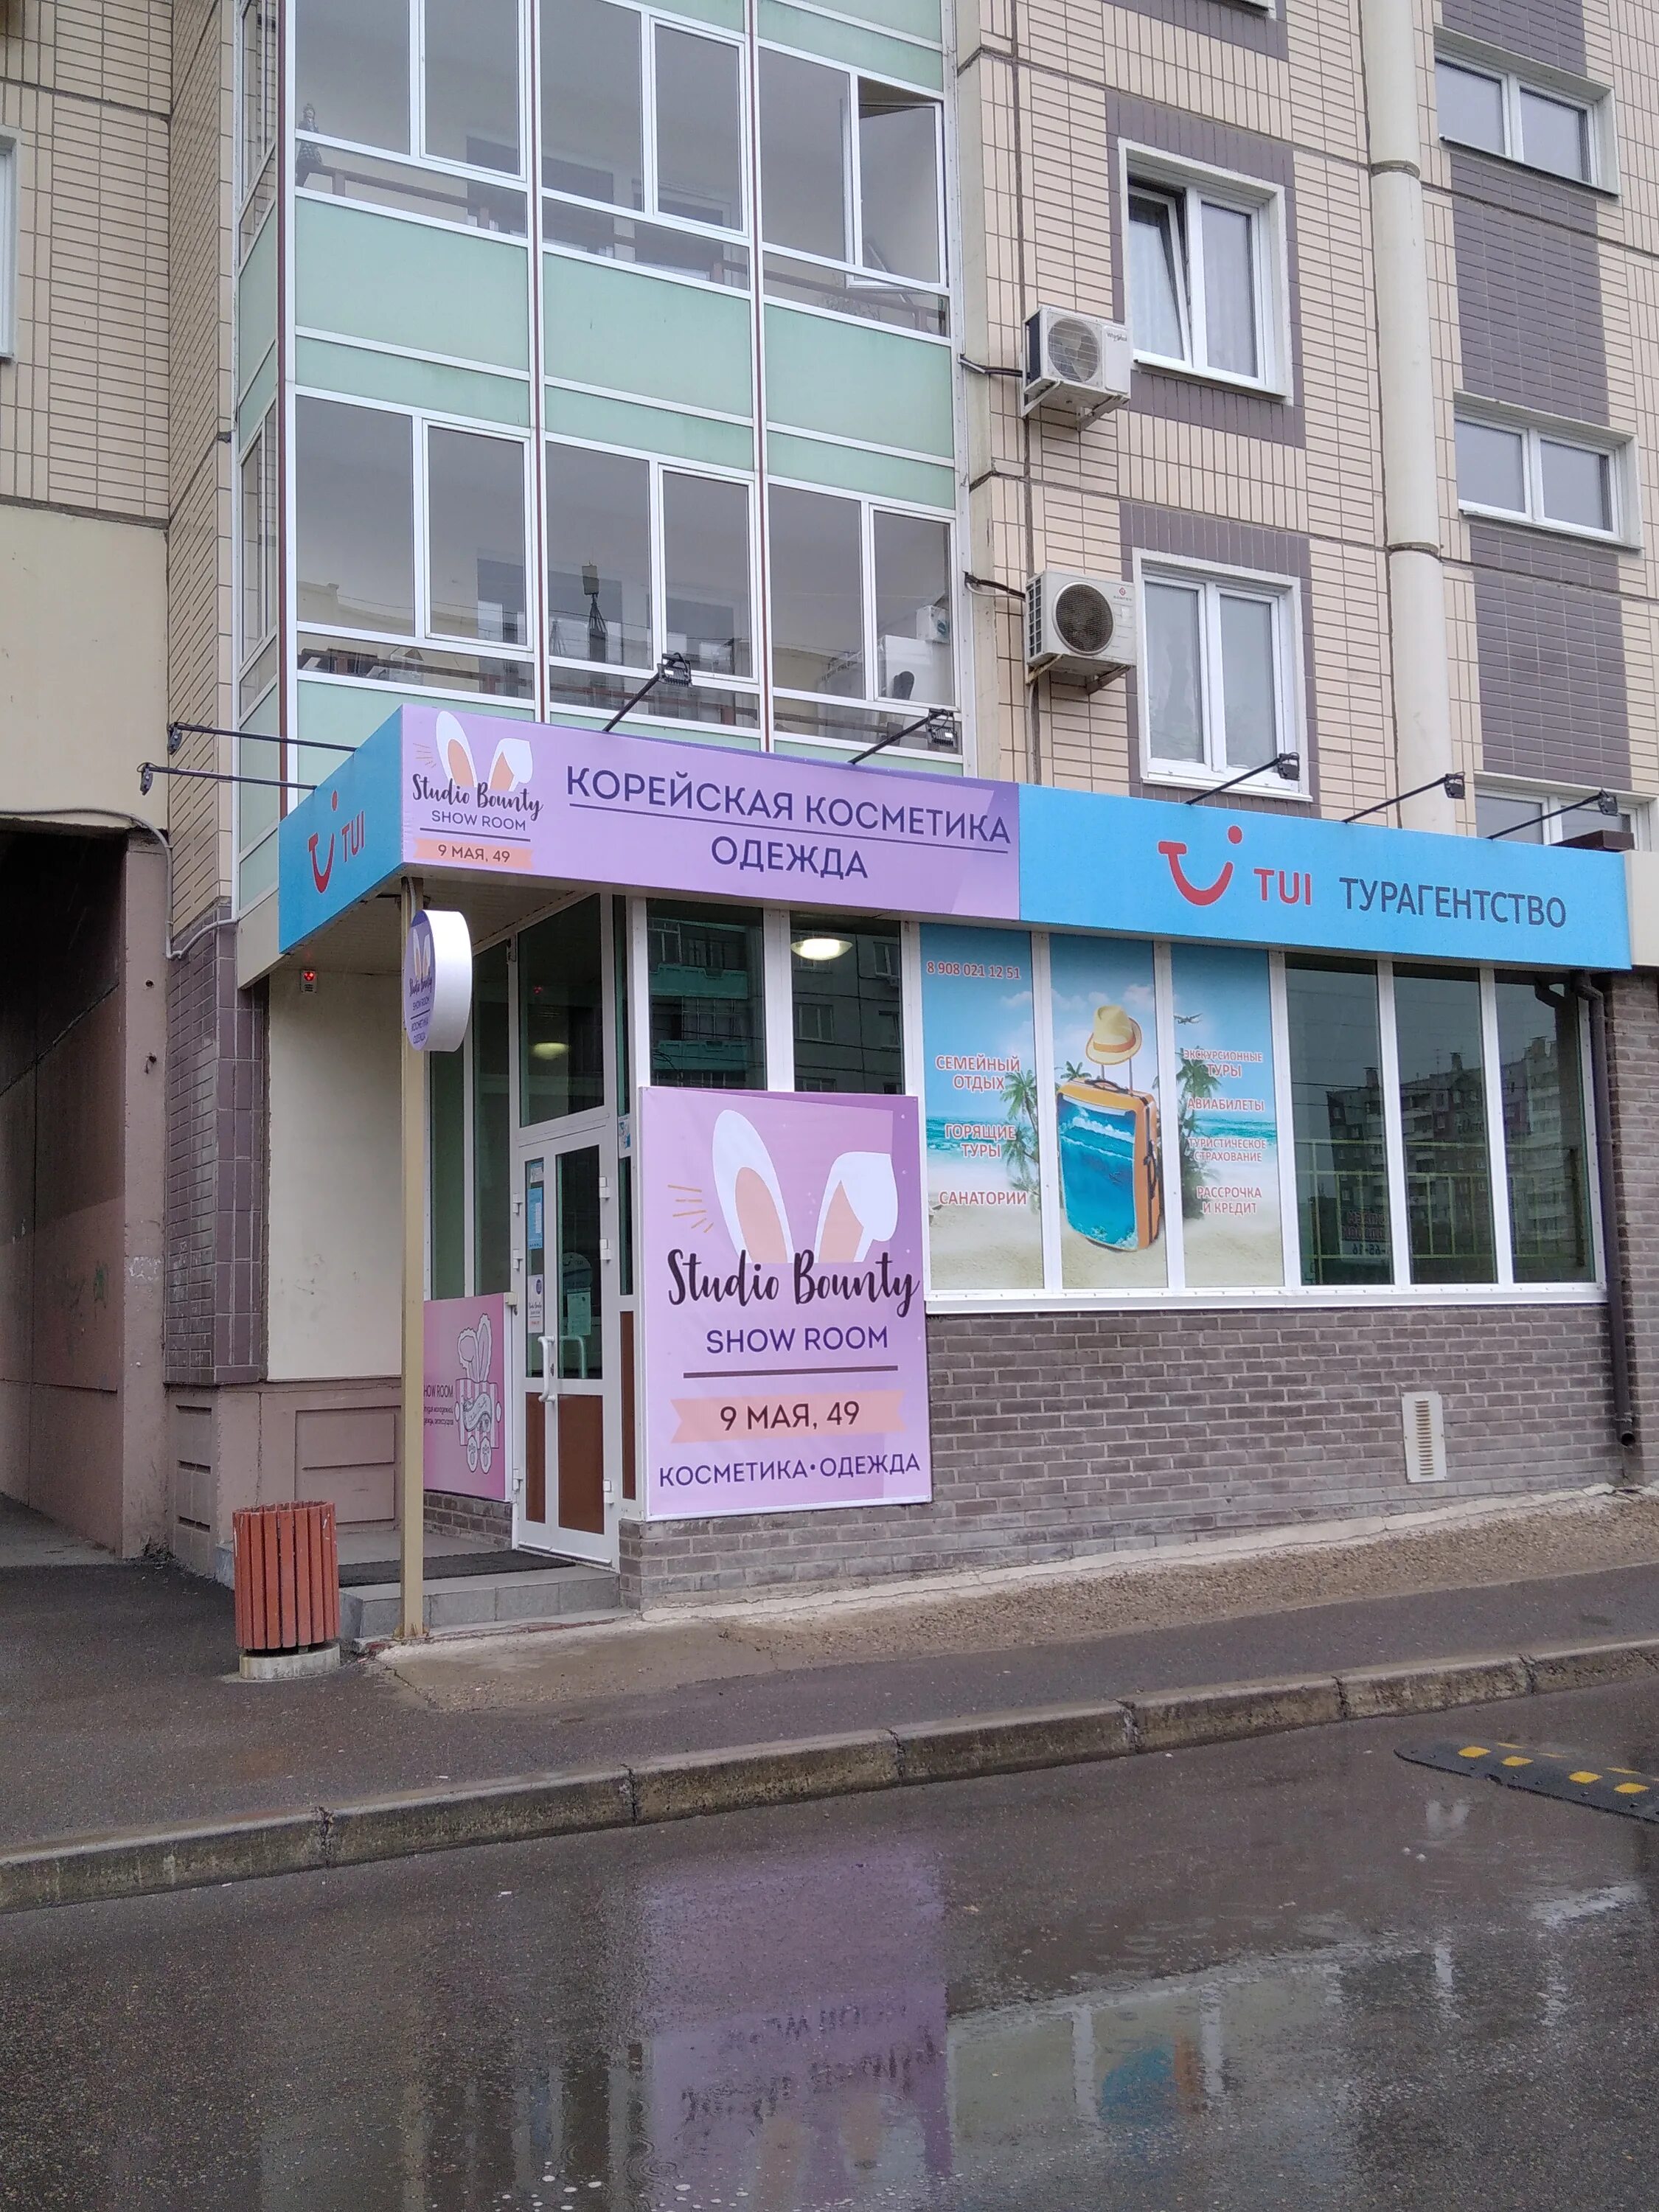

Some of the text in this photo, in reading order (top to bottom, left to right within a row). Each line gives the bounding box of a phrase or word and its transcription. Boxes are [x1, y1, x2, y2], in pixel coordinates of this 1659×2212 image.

[412, 773, 544, 821] Studio Bounty
[566, 765, 1011, 845] КОРЕЙСКАЯ КОСМЕТИКА
[431, 810, 526, 831] SHOW ROOM
[341, 810, 364, 863] TUI
[438, 844, 510, 863] 9 МАЯ, 49
[712, 836, 868, 880] ОДЕЖДА
[1253, 867, 1312, 905] TUI
[1339, 877, 1567, 928] ТУРАГЕНТСТВО
[927, 962, 1020, 979] 8 908 021 12 51
[936, 1054, 1020, 1072] СЕМЕЙНЫЙ
[1183, 1050, 1262, 1062] ЭКСКУРСИОННЫЕ
[1206, 1063, 1242, 1077] ТУРЫ
[953, 1076, 1005, 1092] ОТДЫХ
[1188, 1098, 1265, 1111] АВИАБИЛЕТЫ
[945, 1124, 1016, 1141] ГОРЯЩИЕ
[961, 1144, 1001, 1158] ТУРЫ
[1188, 1138, 1266, 1150] ТУРИСТИЧЕСКОЕ
[1194, 1151, 1262, 1162] СТРАХОВАНИЕ
[939, 1191, 1027, 1206] САНАТОРИИ
[1197, 1186, 1262, 1199] РАССРОЧКА
[1203, 1203, 1257, 1216] И КРЕДИТ
[667, 1248, 920, 1318] Studio Bounty
[706, 1326, 888, 1354] SHOW ROOM
[424, 1385, 453, 1398] HOW ROOM
[720, 1401, 860, 1431] 9 МАЯ, 49
